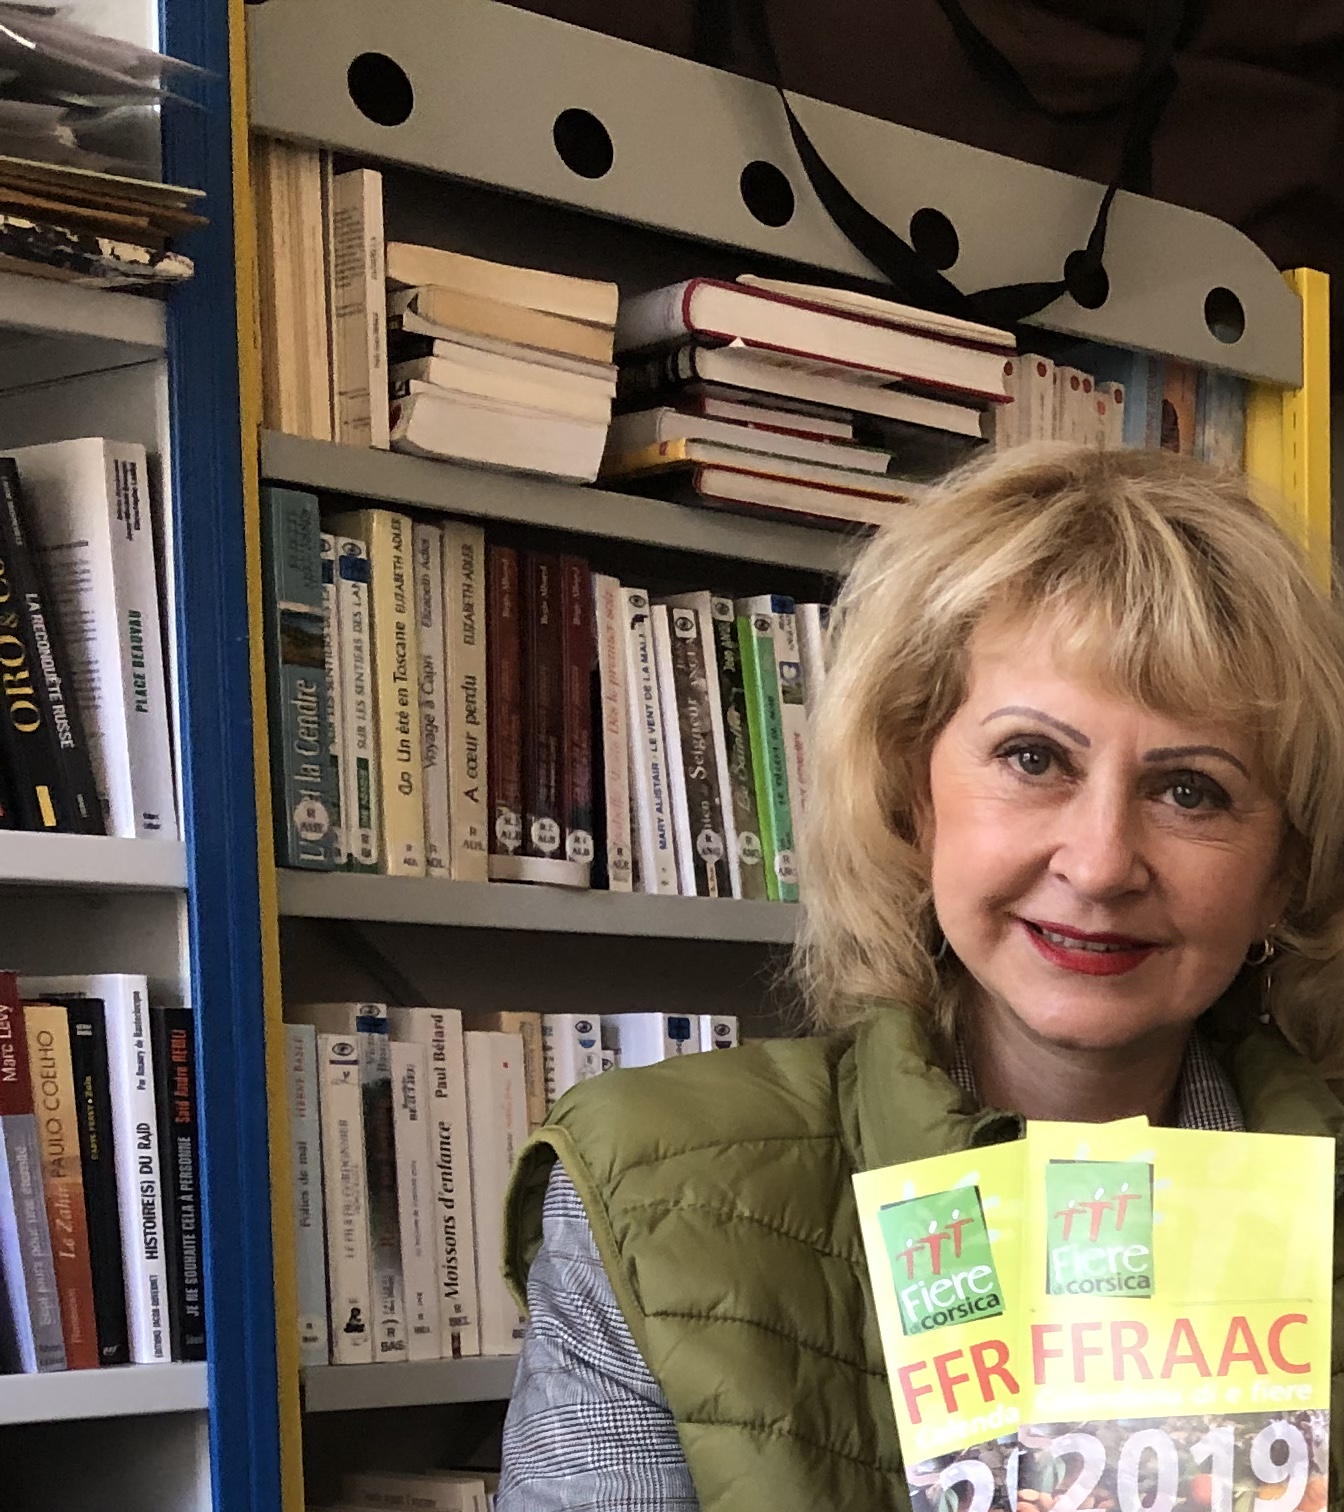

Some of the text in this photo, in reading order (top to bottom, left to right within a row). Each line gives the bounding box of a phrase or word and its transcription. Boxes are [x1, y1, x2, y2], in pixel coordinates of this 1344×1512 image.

[390, 517, 411, 763] Un été en Toscane ELIZABETH ADLER
[462, 584, 476, 645] ELIZABETH
[3, 632, 41, 733] ORO
[133, 672, 148, 713] PLACE
[460, 674, 480, 726] perdu
[52, 701, 74, 750] RUSSE
[290, 678, 319, 756] Cendre
[464, 732, 479, 779] cœur
[462, 786, 478, 803] A
[2, 1043, 18, 1083] Marc
[36, 1031, 67, 1179] PAULO COELHO
[177, 1136, 193, 1191] PERSONNE
[430, 1014, 460, 1300] Moissons d'enfance Paul Bélard
[136, 1121, 159, 1261] HISTOIRE(S) DU RAID
[179, 1204, 195, 1231] CELA
[181, 1233, 197, 1285] SOUHAITE
[1050, 1241, 1150, 1282] Fiere
[1065, 1274, 1152, 1295] corsica
[185, 1303, 200, 1317] JE
[900, 1263, 993, 1324] Fiere
[920, 1290, 1002, 1330] corsica
[1030, 1313, 1312, 1386] FFRAAC
[897, 1338, 1020, 1425] FFR
